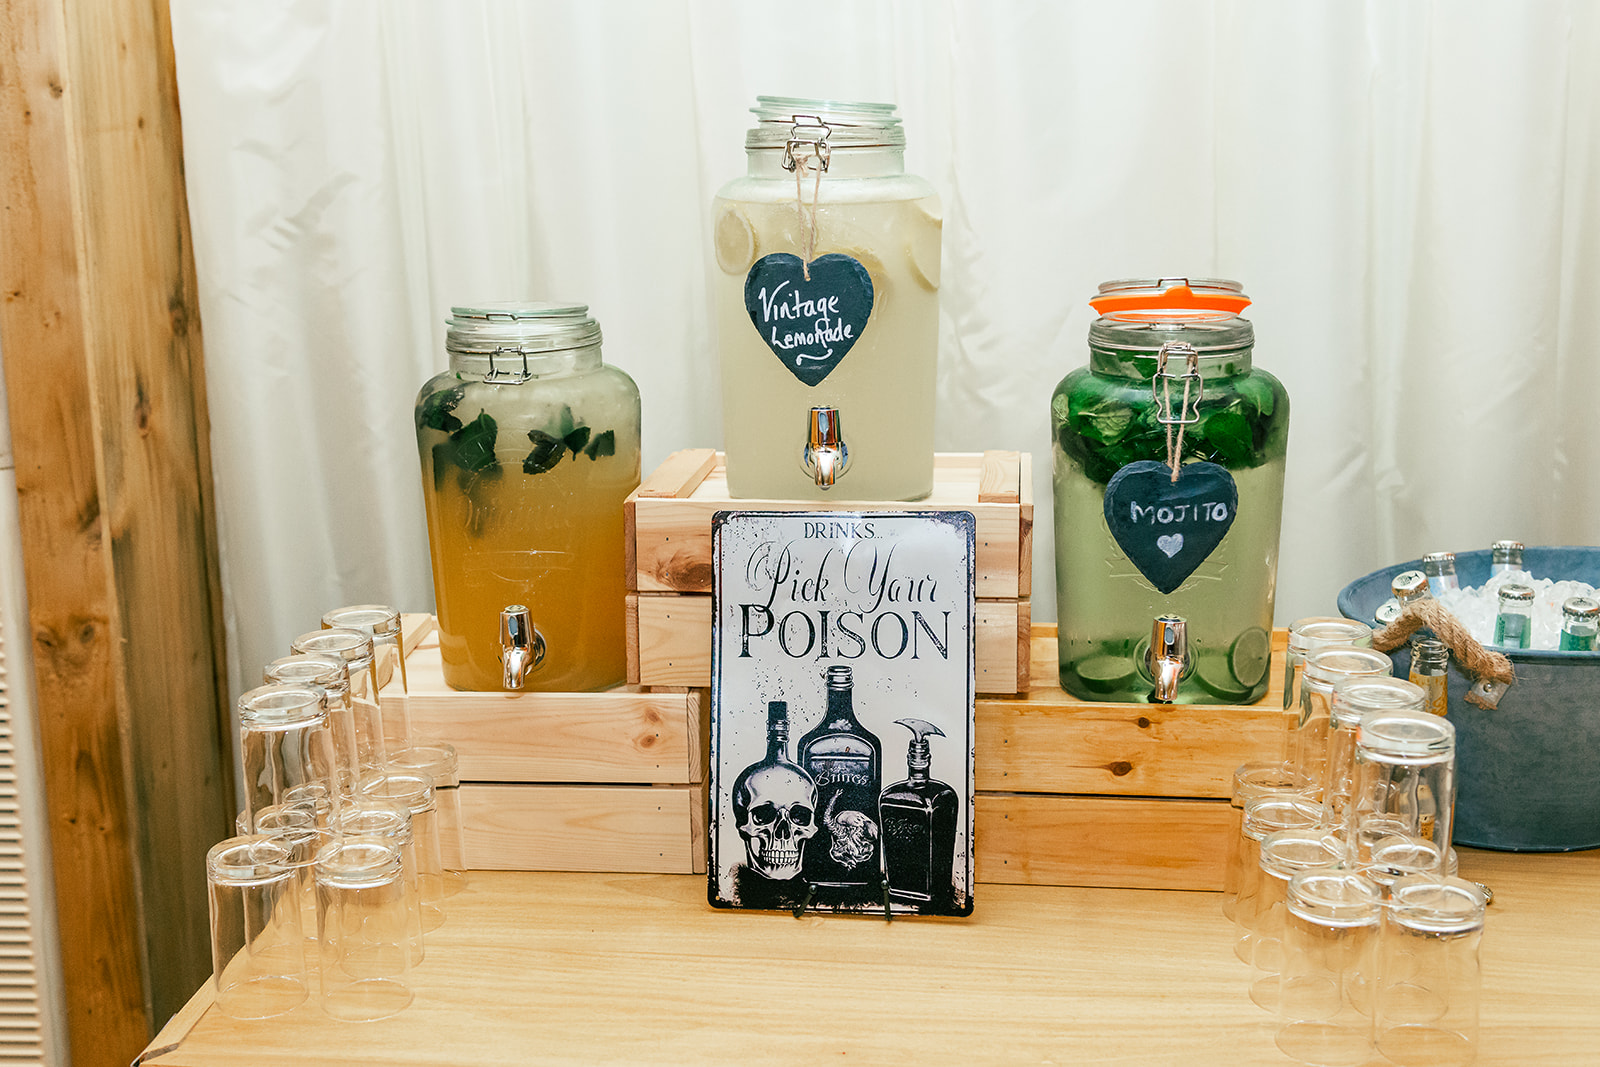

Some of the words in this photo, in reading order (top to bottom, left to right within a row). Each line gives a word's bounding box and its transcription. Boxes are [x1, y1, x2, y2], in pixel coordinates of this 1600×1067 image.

[758, 280, 839, 330] Vintage
[1130, 501, 1228, 525] MOJITO
[747, 540, 834, 613] Pick
[844, 540, 938, 613] Your
[738, 604, 951, 660] POISON
